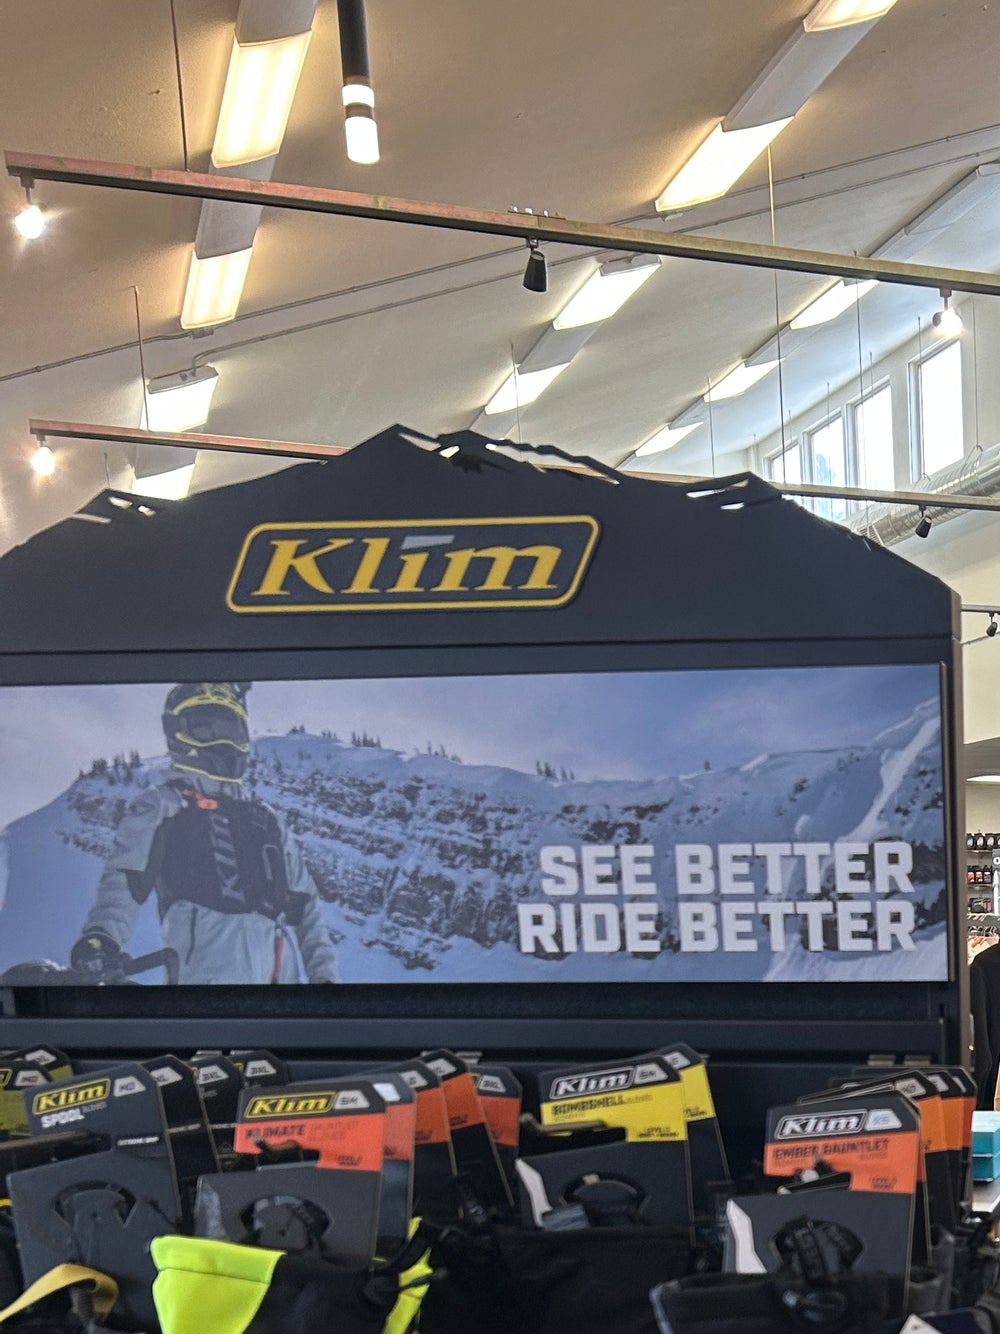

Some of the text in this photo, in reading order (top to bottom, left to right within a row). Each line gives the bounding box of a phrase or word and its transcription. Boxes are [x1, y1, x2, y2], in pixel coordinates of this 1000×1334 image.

[251, 534, 562, 597] Klim
[539, 841, 915, 897] SEE BETTER
[519, 899, 916, 955] RIDE BETTER
[557, 1074, 626, 1096] Klim
[38, 1086, 105, 1112] Klim
[252, 1096, 329, 1116] Klim
[782, 1115, 860, 1136] Klim
